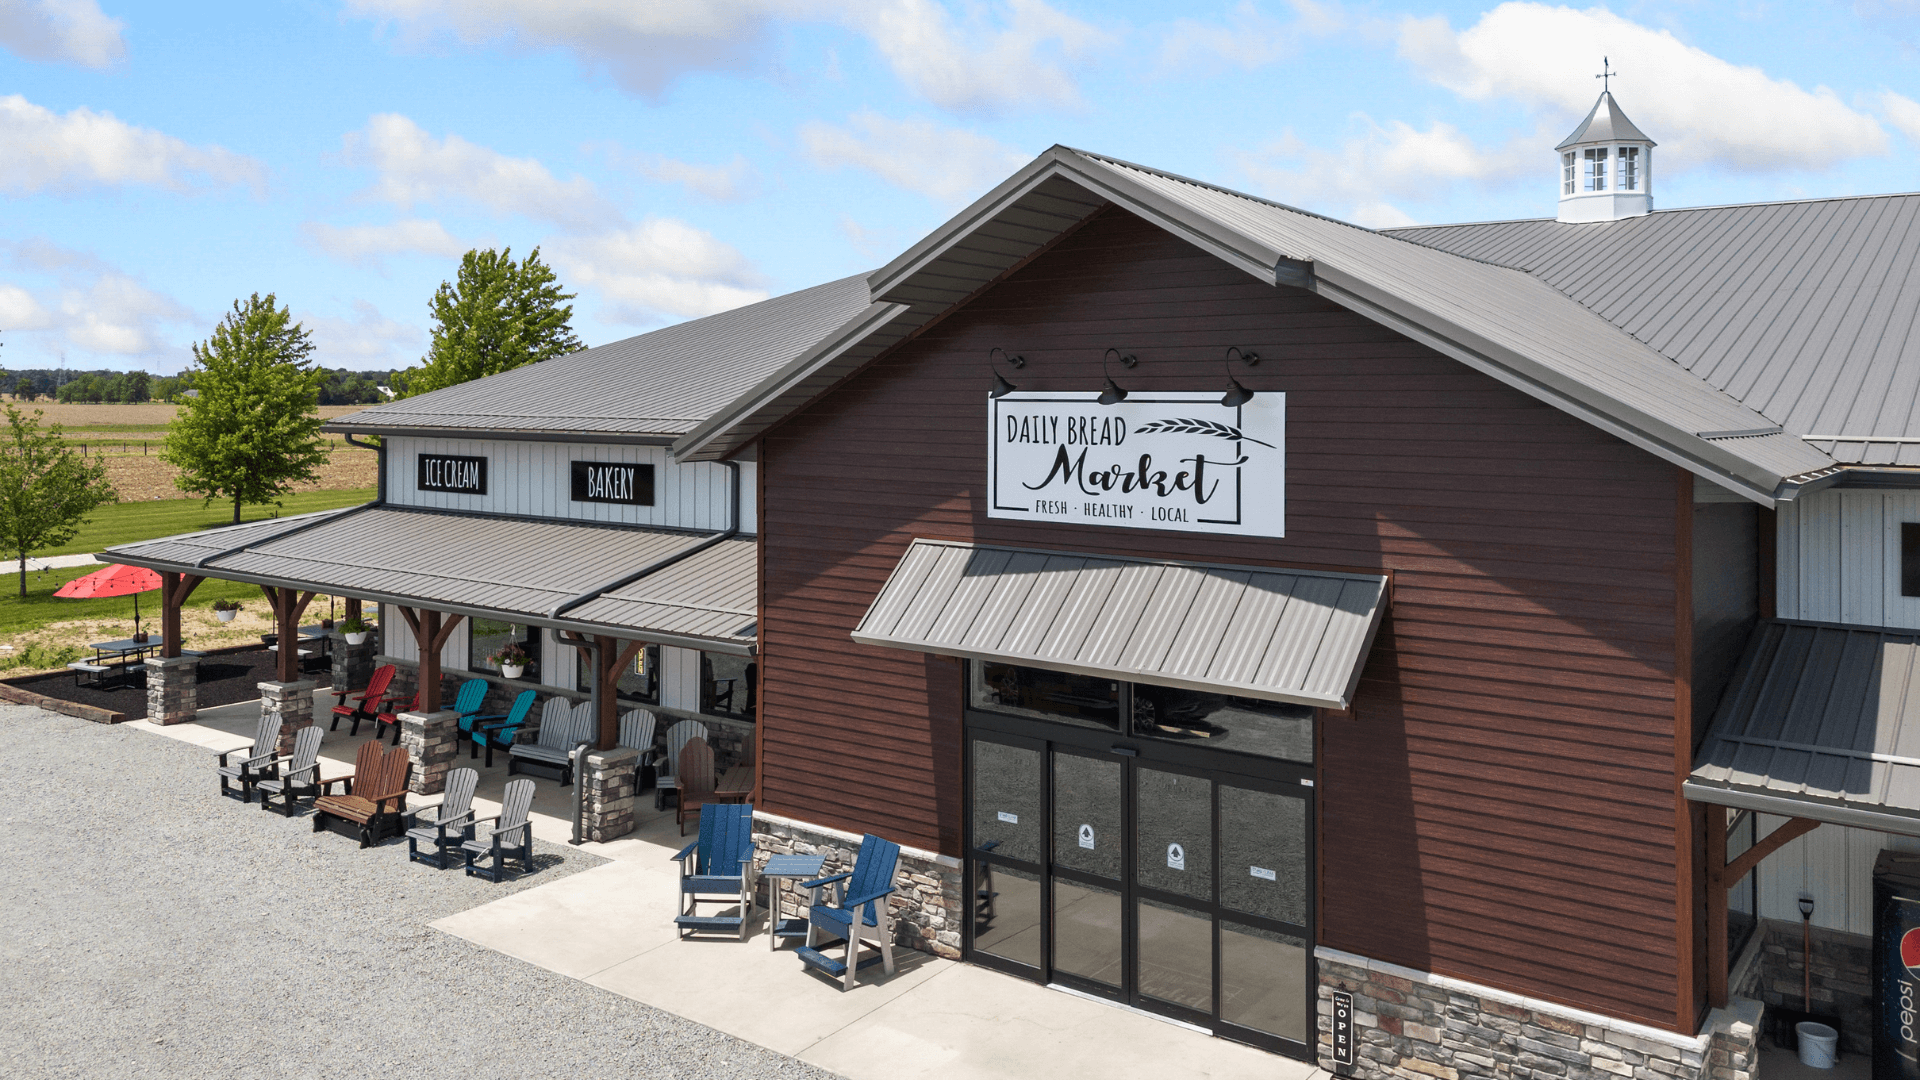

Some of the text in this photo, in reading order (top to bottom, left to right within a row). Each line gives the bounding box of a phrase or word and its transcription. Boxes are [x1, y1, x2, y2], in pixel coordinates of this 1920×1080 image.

[1007, 415, 1126, 446] DAILY BREAD
[425, 459, 479, 490] ICE CREAM
[588, 466, 634, 500] BAKERY
[1022, 443, 1249, 504] Market
[1035, 500, 1189, 523] FRESH HEALTHY LOCAL
[1897, 979, 1918, 1043] pepsi
[1338, 1009, 1346, 1057] OPEN
